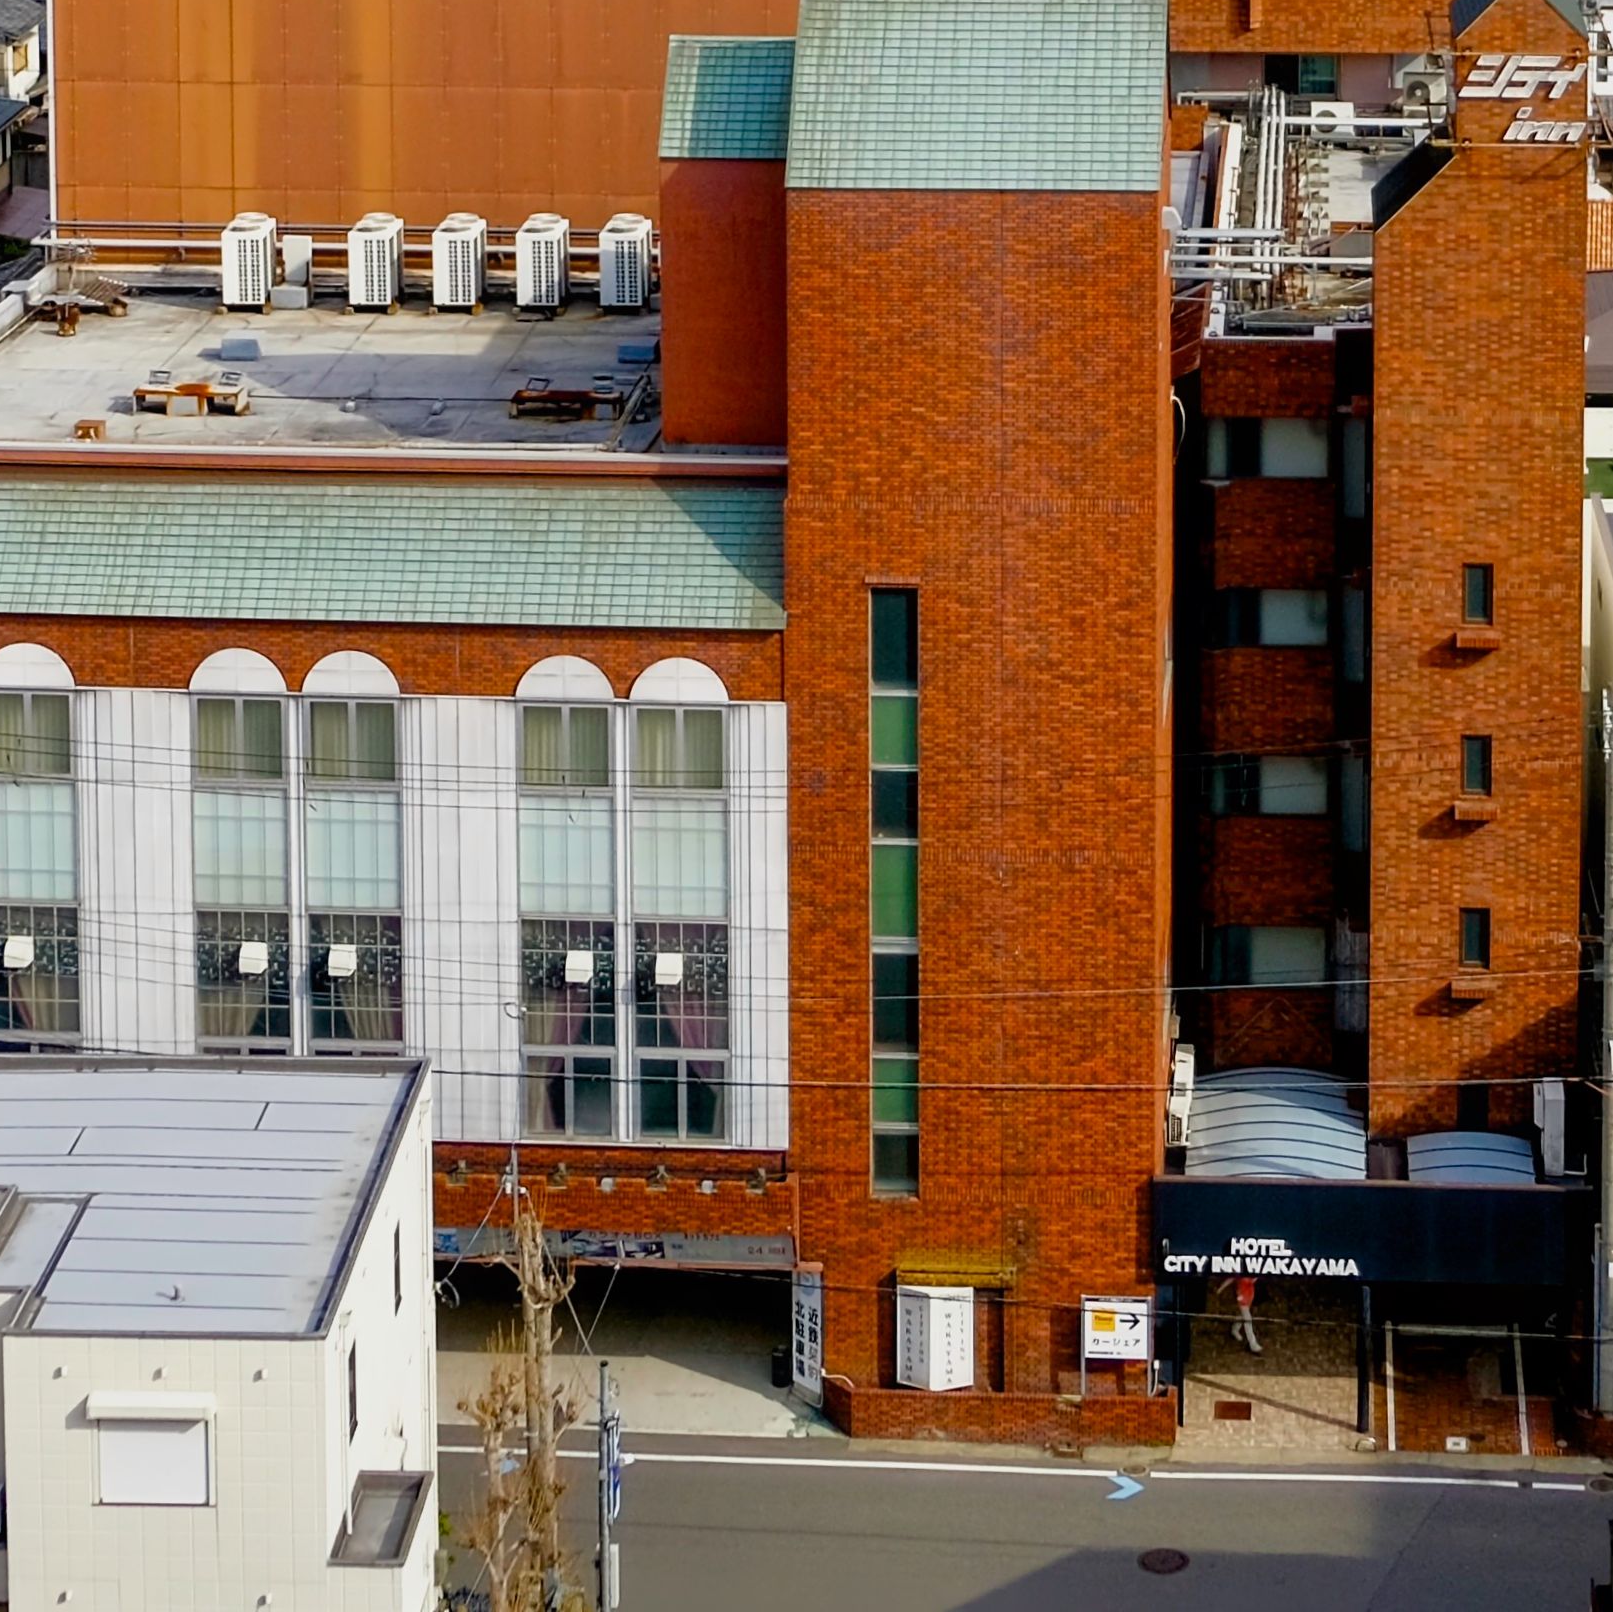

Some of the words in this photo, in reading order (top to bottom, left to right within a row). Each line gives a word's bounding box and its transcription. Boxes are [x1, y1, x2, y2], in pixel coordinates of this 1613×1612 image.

[1503, 106, 1587, 142] inn
[1230, 1237, 1293, 1256] HOTEL
[1164, 1255, 1208, 1273] CITY
[1211, 1256, 1241, 1274] INN
[1245, 1257, 1360, 1276] WAKAYAMA
[1092, 1338, 1141, 1347] カーシェア
